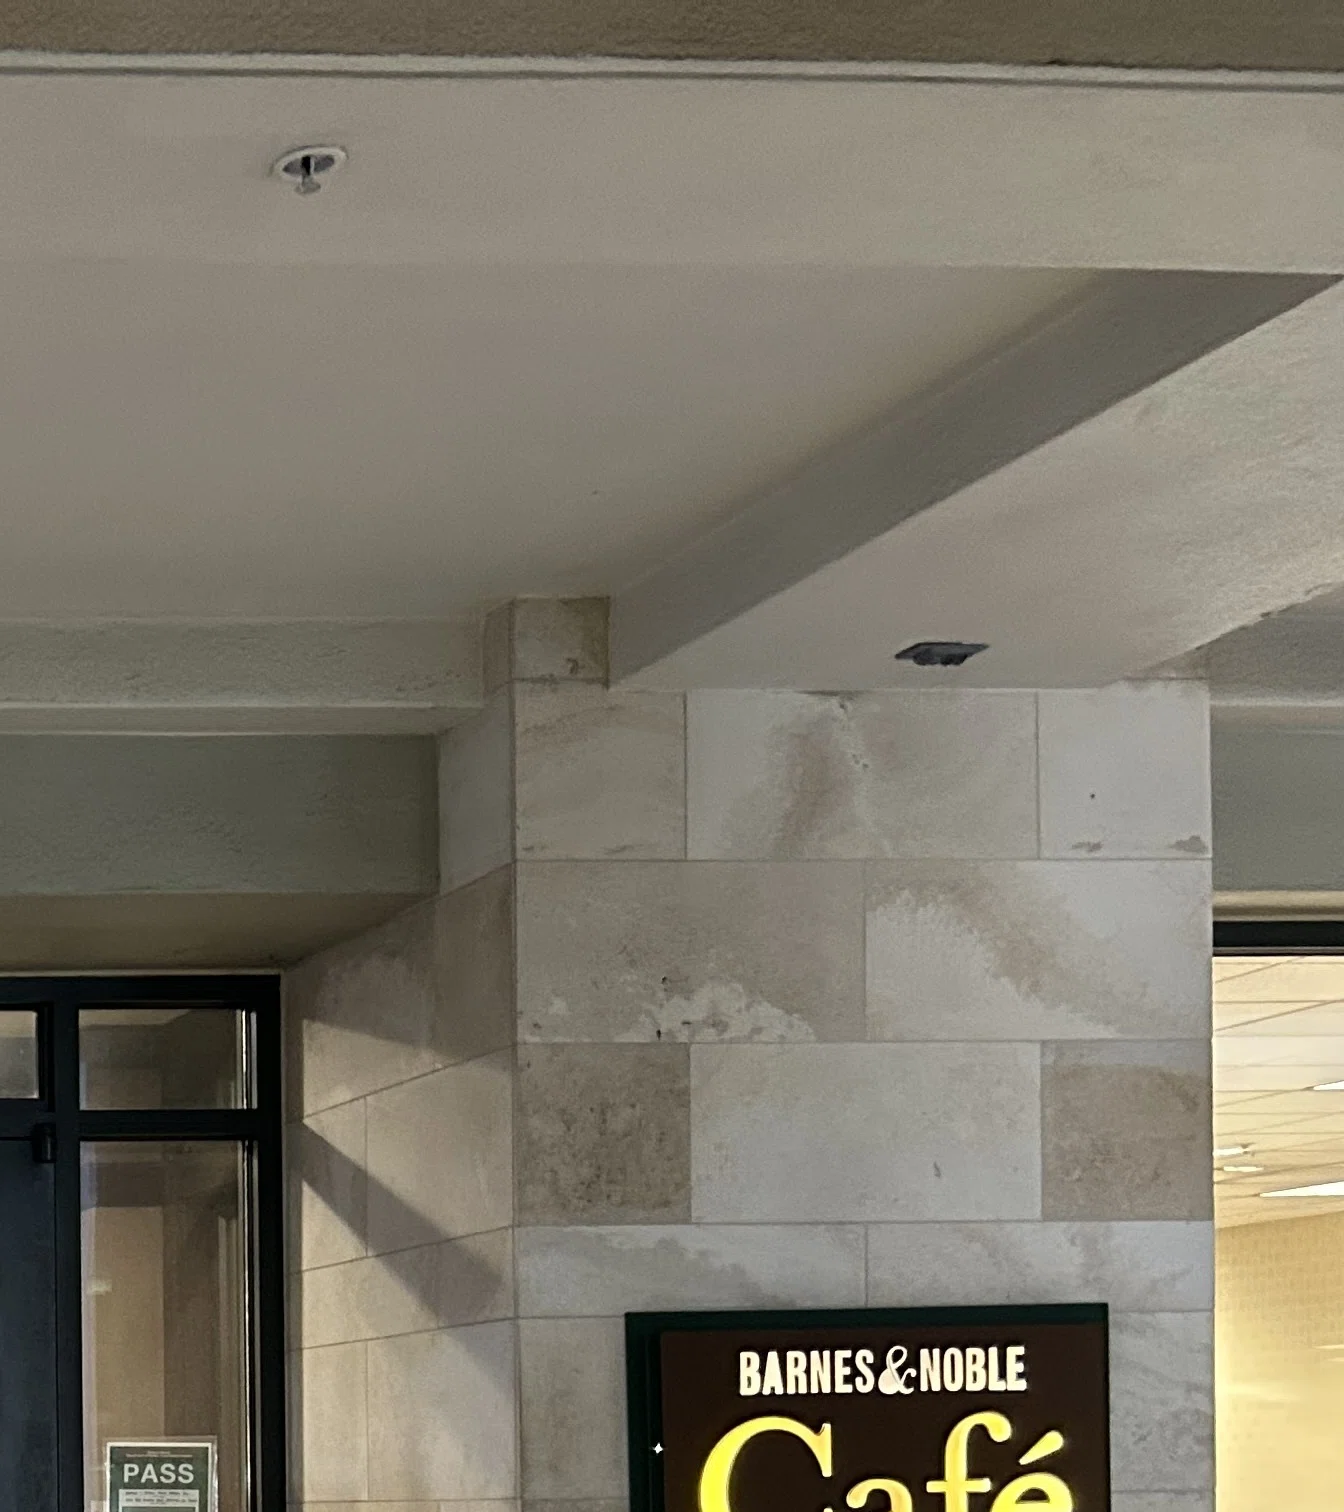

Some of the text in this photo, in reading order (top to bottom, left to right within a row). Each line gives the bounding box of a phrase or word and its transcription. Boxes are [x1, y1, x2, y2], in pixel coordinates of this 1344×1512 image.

[739, 1345, 1028, 1396] BARNES & NOBLE
[123, 1463, 194, 1484] PASS
